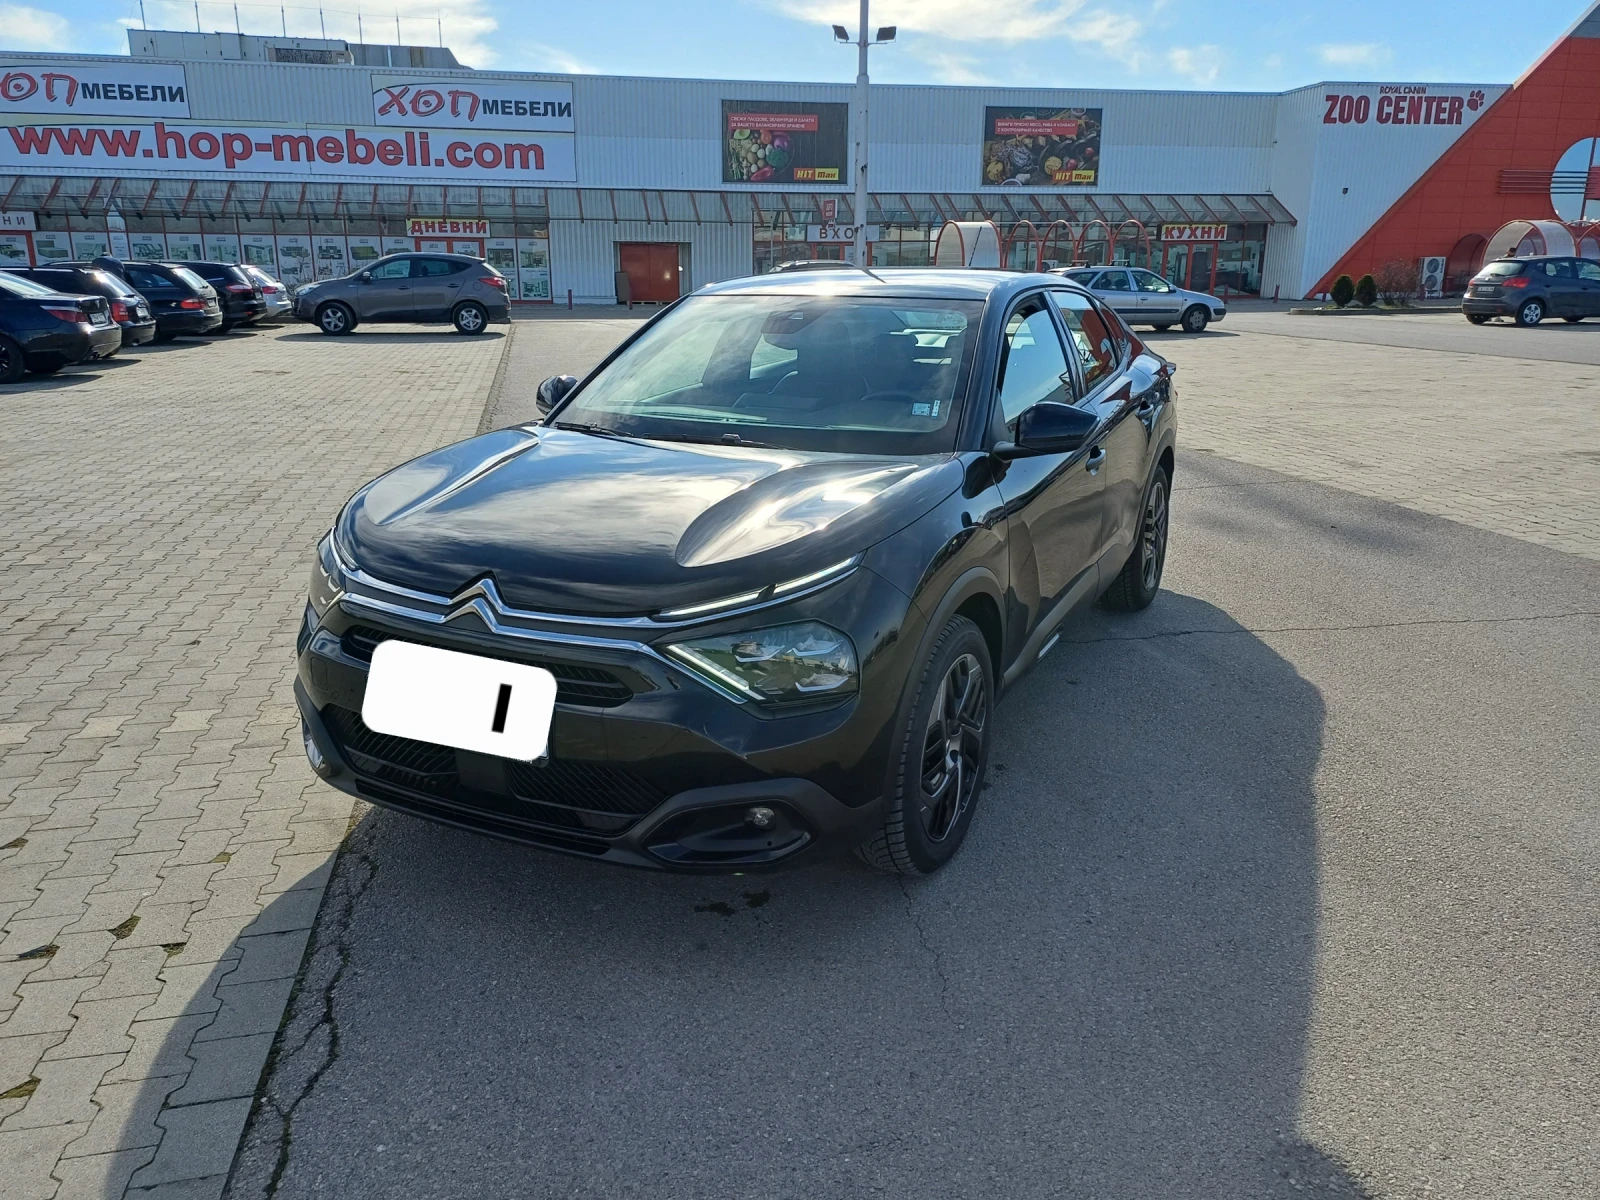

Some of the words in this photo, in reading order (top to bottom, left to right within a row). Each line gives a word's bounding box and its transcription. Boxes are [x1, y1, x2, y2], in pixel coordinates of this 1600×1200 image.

[81, 82, 185, 103] МЕБЕЛИ
[1379, 86, 1402, 95] ROYAL
[1403, 86, 1427, 95] CANIN
[377, 85, 480, 122] ХОП
[482, 98, 572, 118] МЕБЕЛИ
[1323, 95, 1370, 124] ZOO
[1376, 95, 1464, 125] CENTER
[8, 122, 545, 170] www.hop-mebeli.com
[797, 170, 813, 178] HIT
[1055, 172, 1071, 180] HIT
[410, 220, 488, 235] ДНЕВНИ
[819, 227, 854, 239] ВХО
[1164, 226, 1226, 240] КУХНИ
